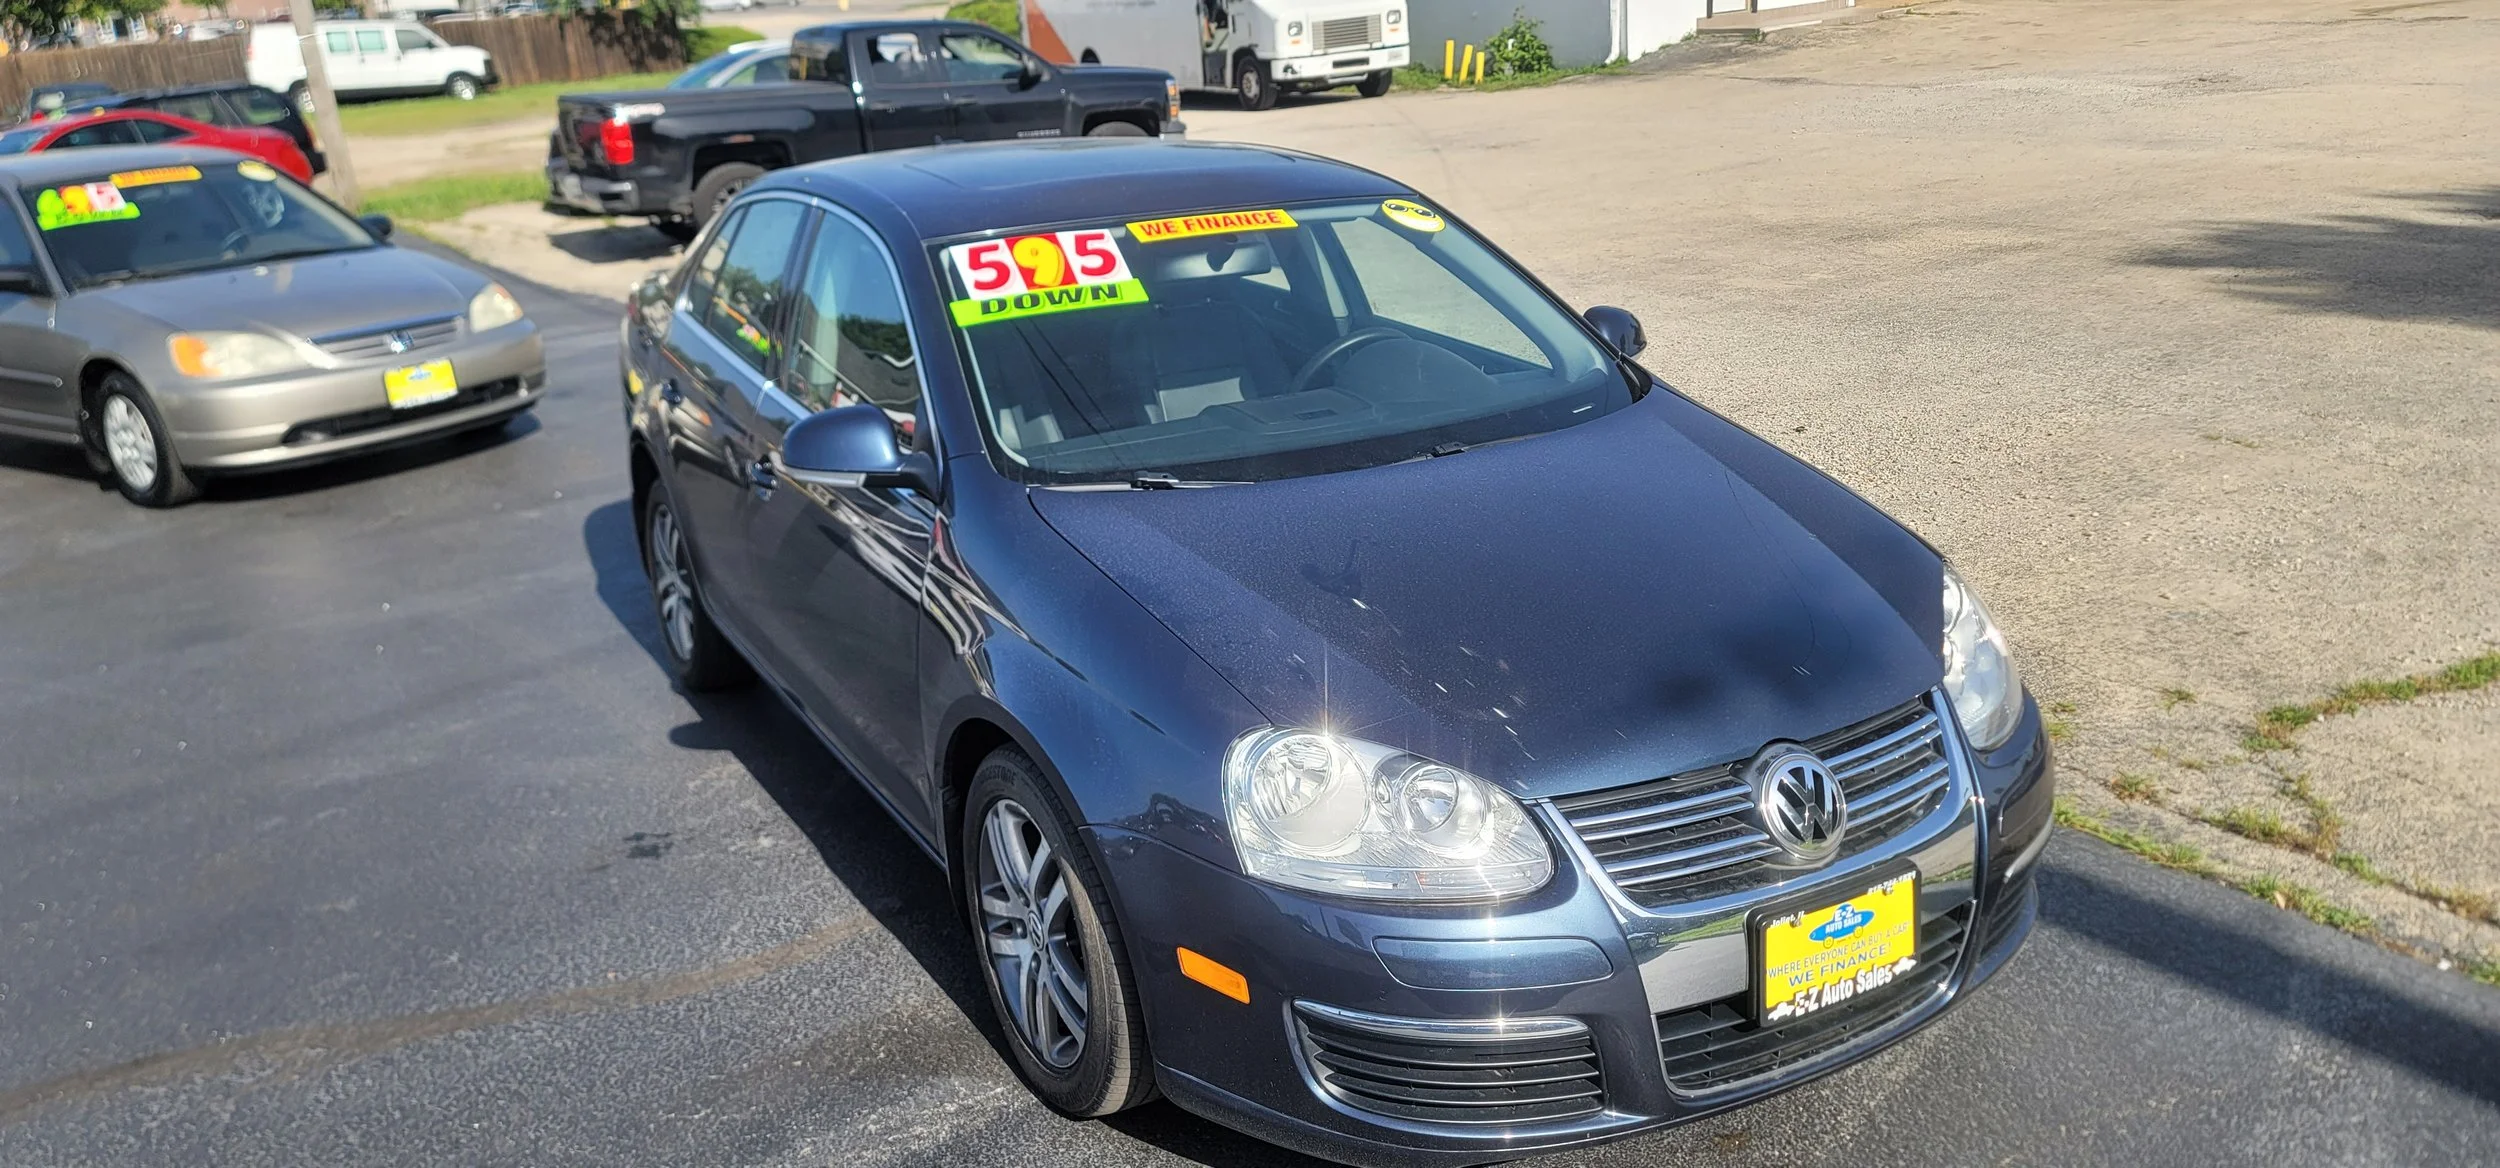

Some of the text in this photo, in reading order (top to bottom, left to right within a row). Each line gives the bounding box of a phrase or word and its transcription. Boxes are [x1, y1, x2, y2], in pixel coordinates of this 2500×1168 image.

[1140, 211, 1282, 237] WE FINANCE
[968, 233, 1118, 291] 595
[981, 283, 1121, 315] DOWN
[1825, 913, 1862, 934] AUTO SALES
[1834, 906, 1854, 922] E-Z
[1788, 942, 1892, 987] WE FINANCE!
[1804, 944, 1848, 969] EVERYONE
[1851, 938, 1866, 953] CAN
[1868, 932, 1883, 946] BUY
[1794, 964, 1893, 1017] E-Z Auto Sales
